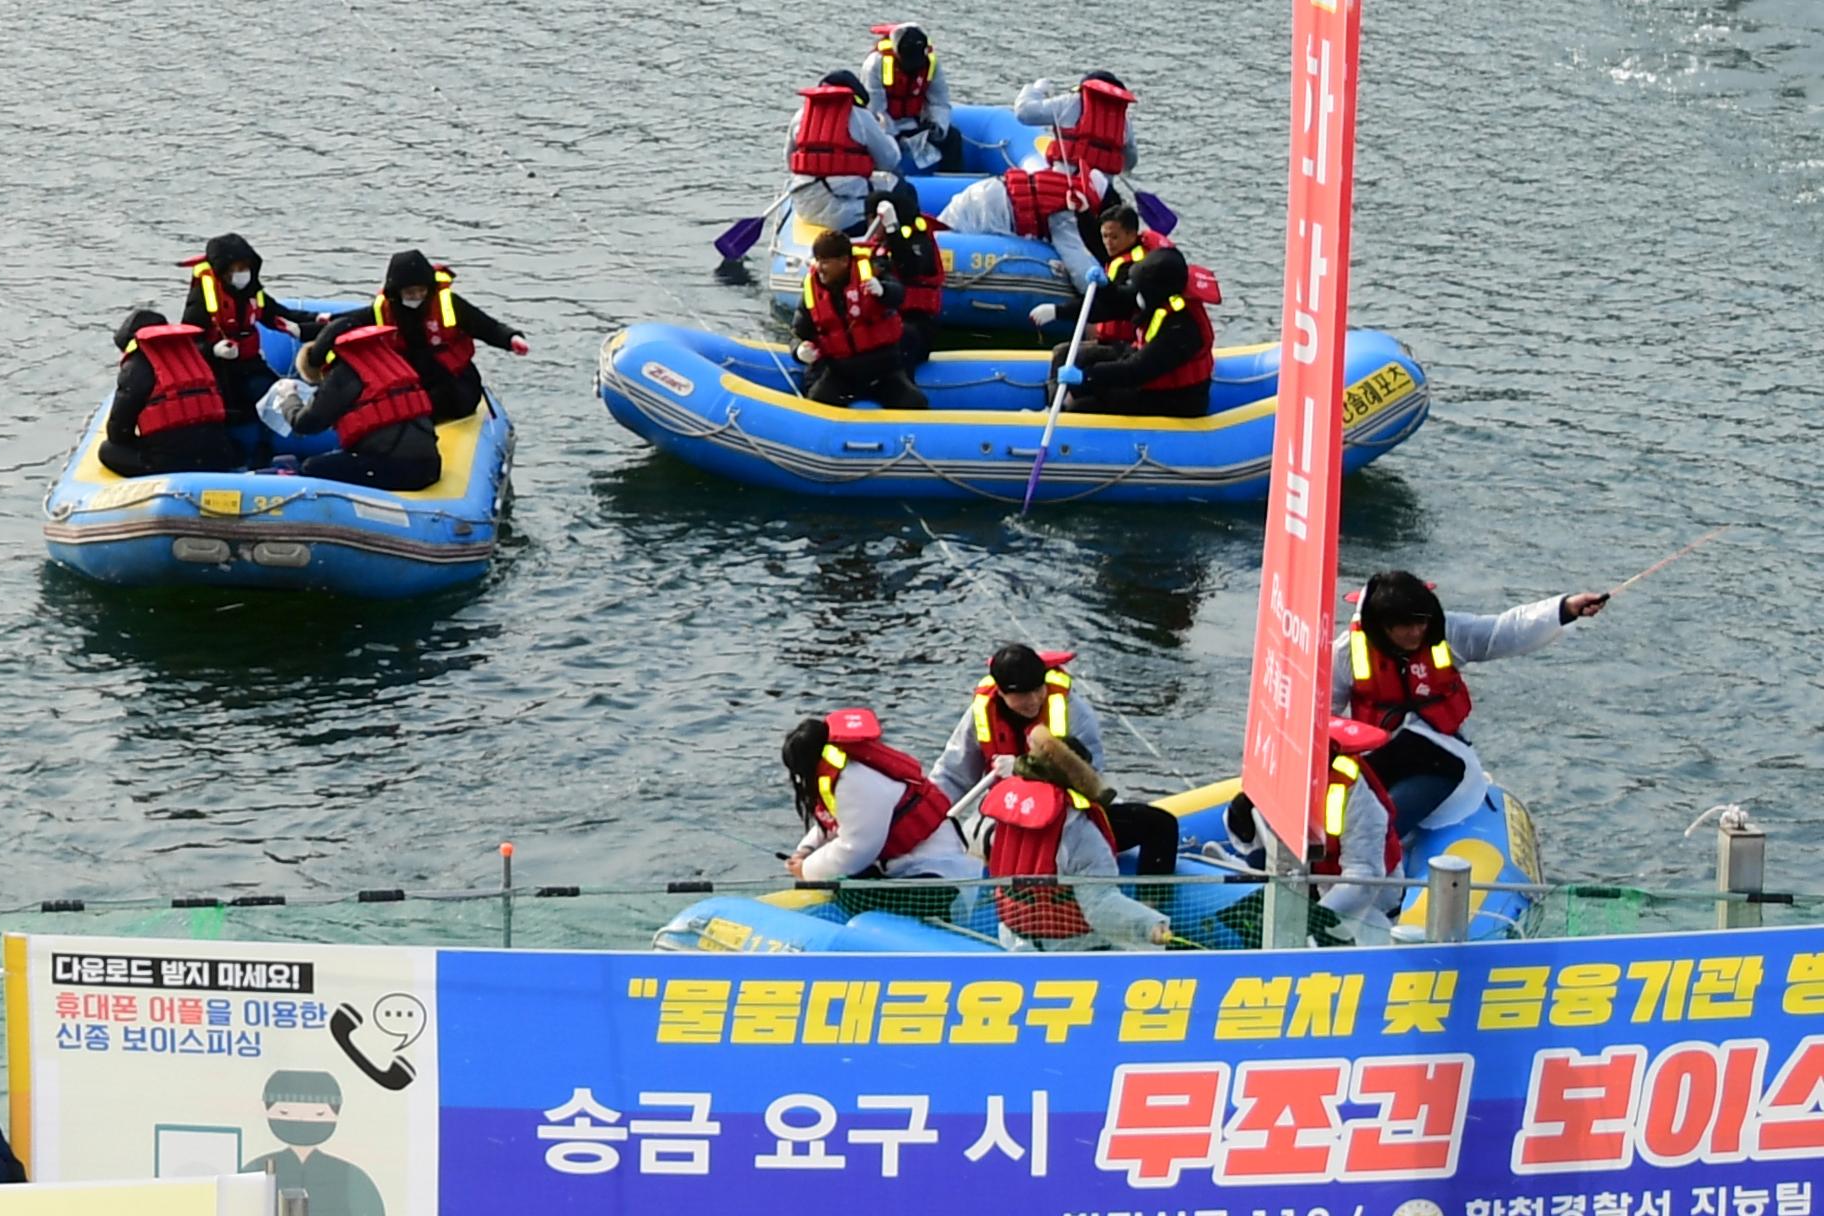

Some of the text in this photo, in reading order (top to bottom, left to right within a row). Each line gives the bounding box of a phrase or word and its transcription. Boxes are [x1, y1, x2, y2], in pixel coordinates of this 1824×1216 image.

[54, 955, 301, 990] 다운로드 받지 마세요!
[54, 991, 329, 1031] 휴대폰 어플을 이용한
[628, 975, 1098, 1044] "물품대금요구
[1118, 978, 1197, 1042] 앱
[1214, 971, 1365, 1040] 설치
[1382, 970, 1460, 1034] 및
[1477, 955, 1764, 1031] 금융기관
[55, 1023, 263, 1058] 신종 보이스피싱
[536, 1086, 722, 1176] 송금
[754, 1093, 939, 1179] 요구
[963, 1089, 1048, 1178] 시
[1096, 1053, 1475, 1188] 무조건
[1690, 1182, 1813, 1216] 지능팀
